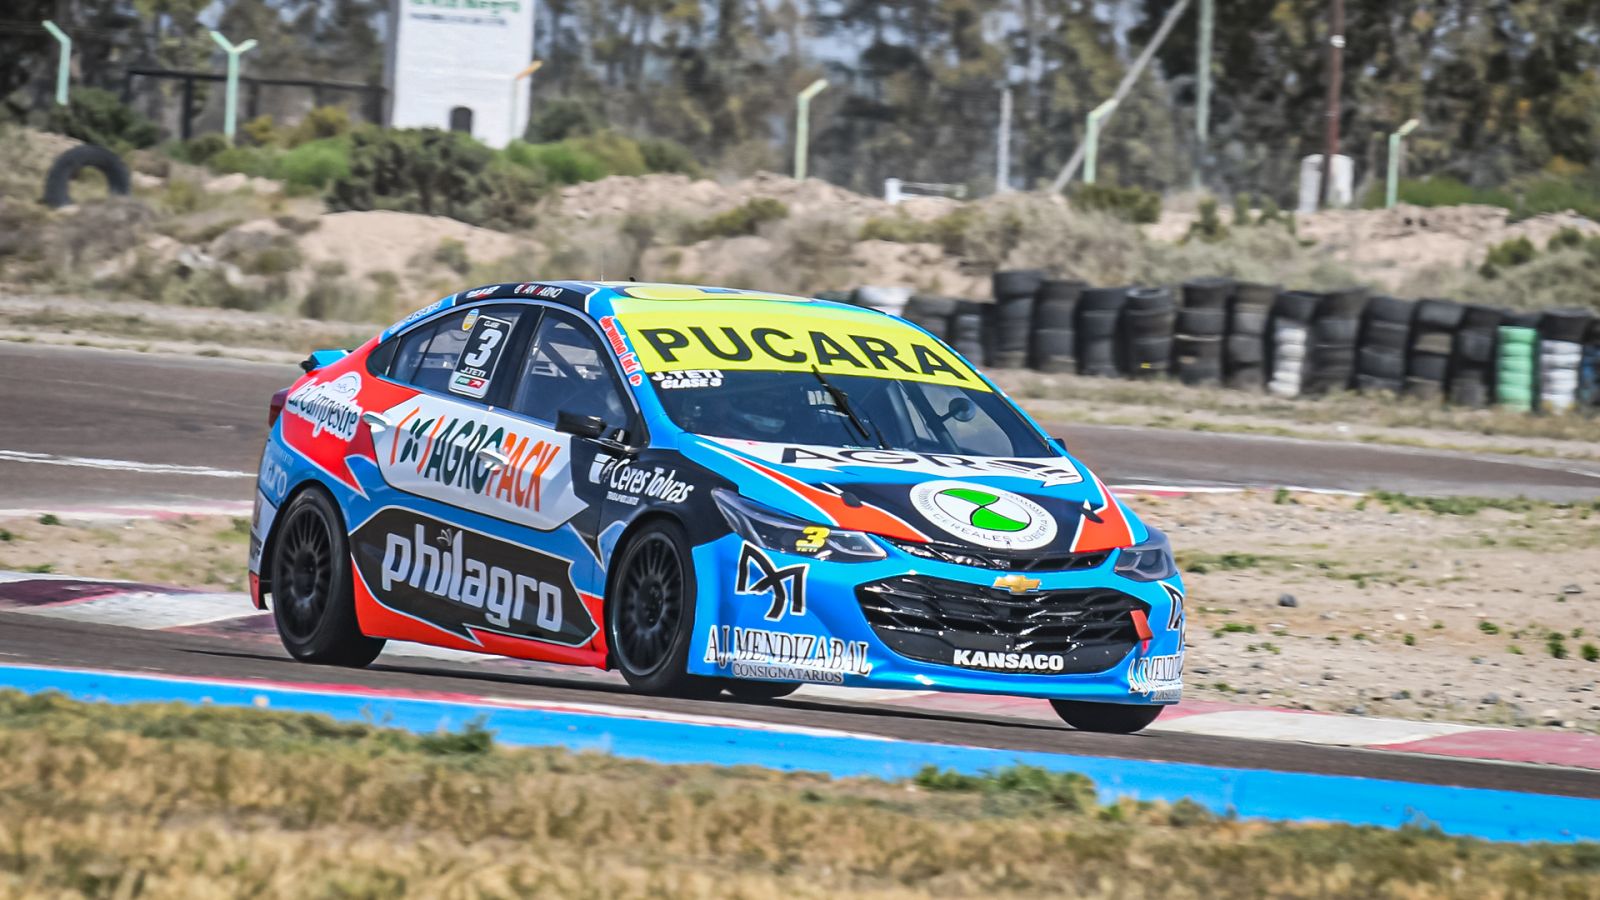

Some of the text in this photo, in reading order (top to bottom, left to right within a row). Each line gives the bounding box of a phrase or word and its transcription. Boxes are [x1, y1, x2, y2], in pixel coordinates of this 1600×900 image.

[464, 328, 503, 367] 3
[637, 326, 970, 381] PUCARA
[651, 369, 724, 381] J.TETI
[661, 378, 709, 389] CLASE
[424, 418, 561, 512] AGROPACK
[610, 458, 652, 494] Ceres
[644, 466, 695, 503] Tolvas
[795, 526, 830, 548] 3
[932, 513, 1014, 544] CEREALES
[381, 523, 563, 632] philagro
[733, 628, 871, 675] MENDIZABAL
[953, 649, 1064, 671] KANSACO
[732, 662, 843, 683] CONSIGNATARIOS
